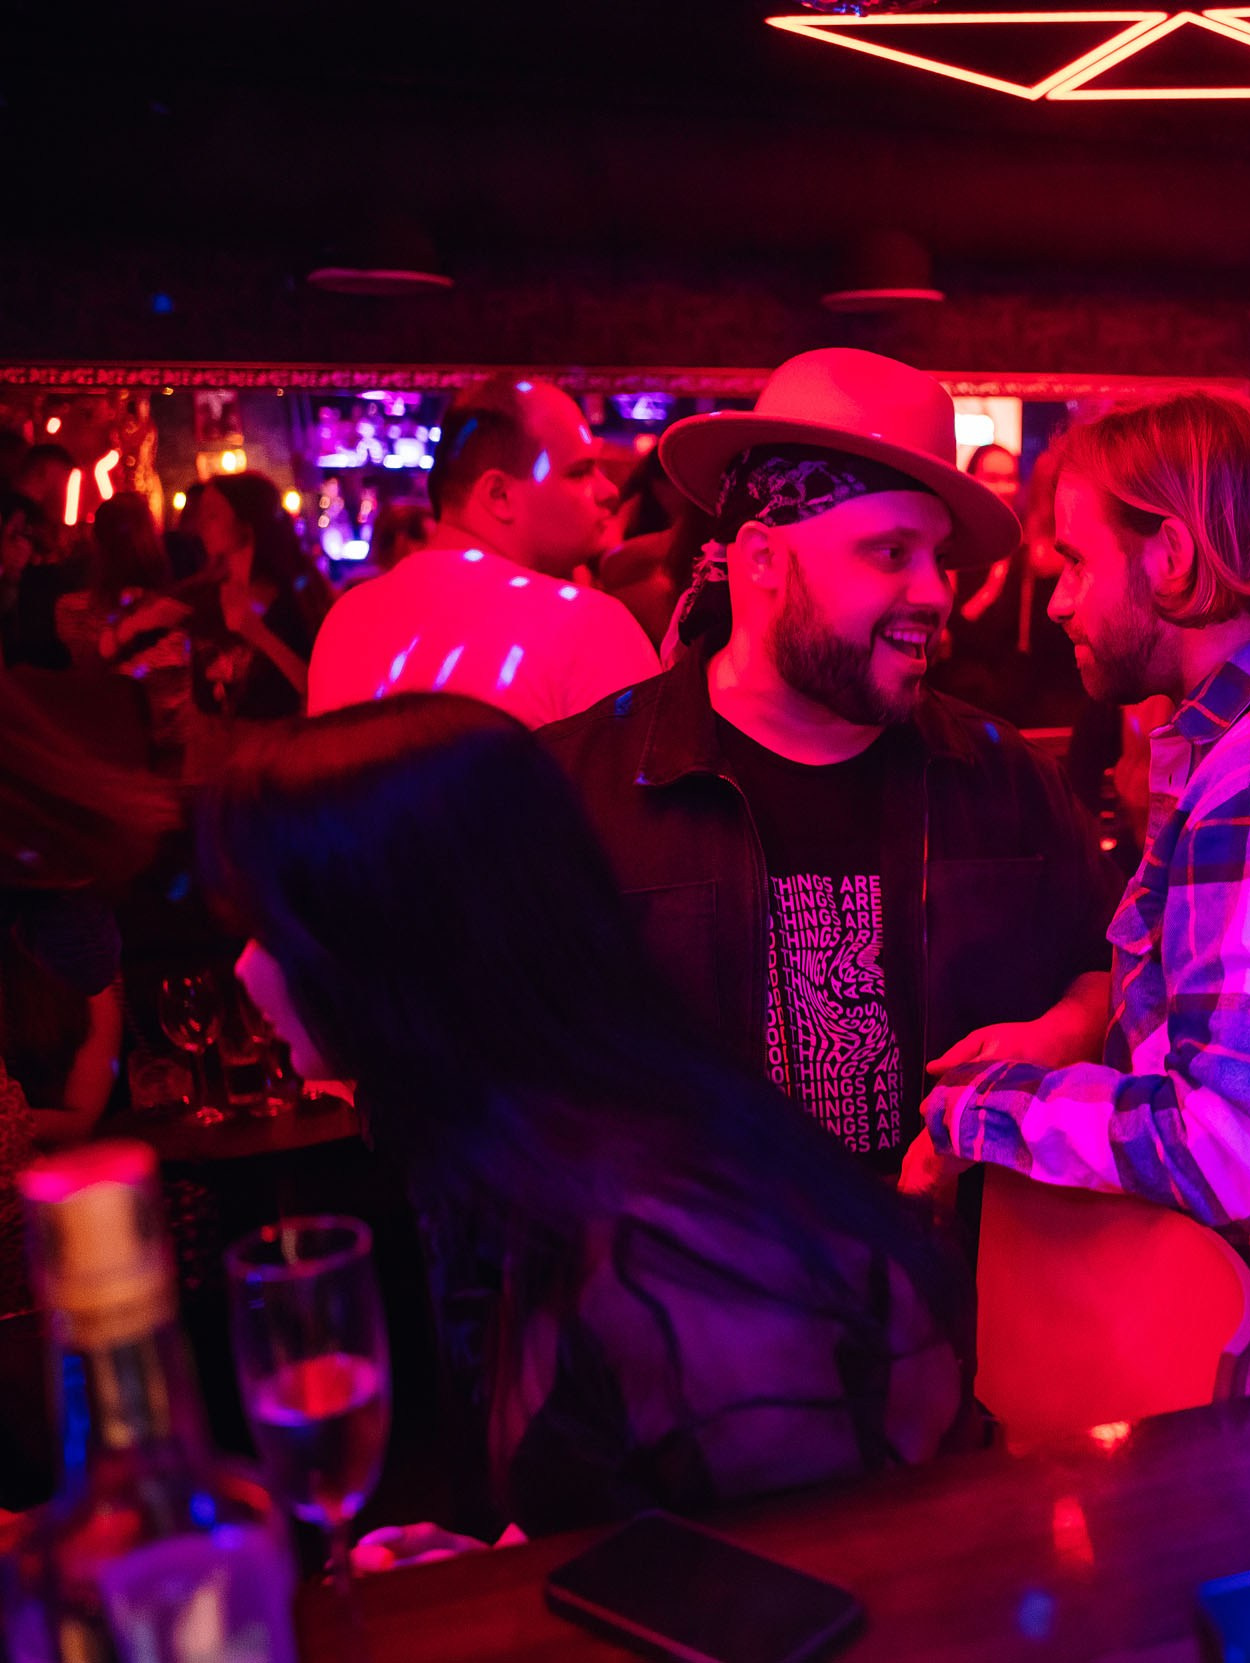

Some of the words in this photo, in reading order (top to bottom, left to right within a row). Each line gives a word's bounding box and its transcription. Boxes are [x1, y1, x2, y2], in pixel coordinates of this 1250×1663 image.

[770, 873, 833, 895] THINGS
[840, 875, 882, 893] ARE
[774, 891, 836, 912] THINGS
[842, 893, 883, 911] ARE
[777, 909, 841, 930] THINGS
[845, 911, 883, 929] ARE
[779, 927, 842, 948] THINGS
[873, 1047, 899, 1073] AR
[874, 1073, 898, 1094] AR
[876, 1090, 900, 1112] AR
